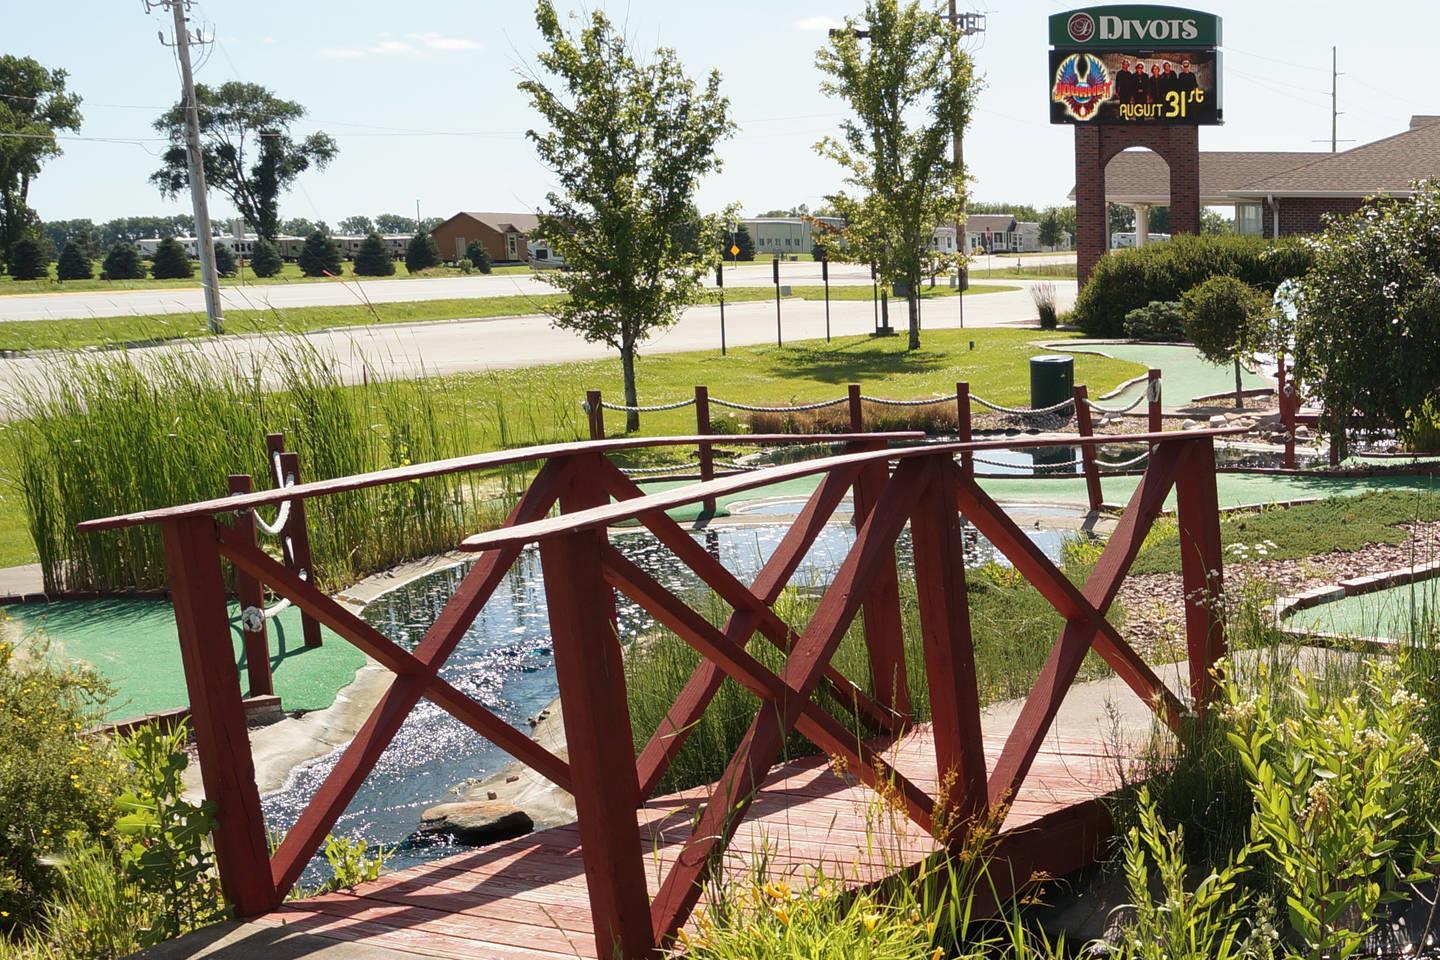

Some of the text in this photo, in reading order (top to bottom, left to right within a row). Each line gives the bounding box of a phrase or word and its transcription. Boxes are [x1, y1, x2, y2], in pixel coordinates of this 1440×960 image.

[1099, 15, 1198, 40] DIVOTS
[1055, 79, 1113, 100] JOURNEY
[1119, 103, 1163, 120] AUGUST
